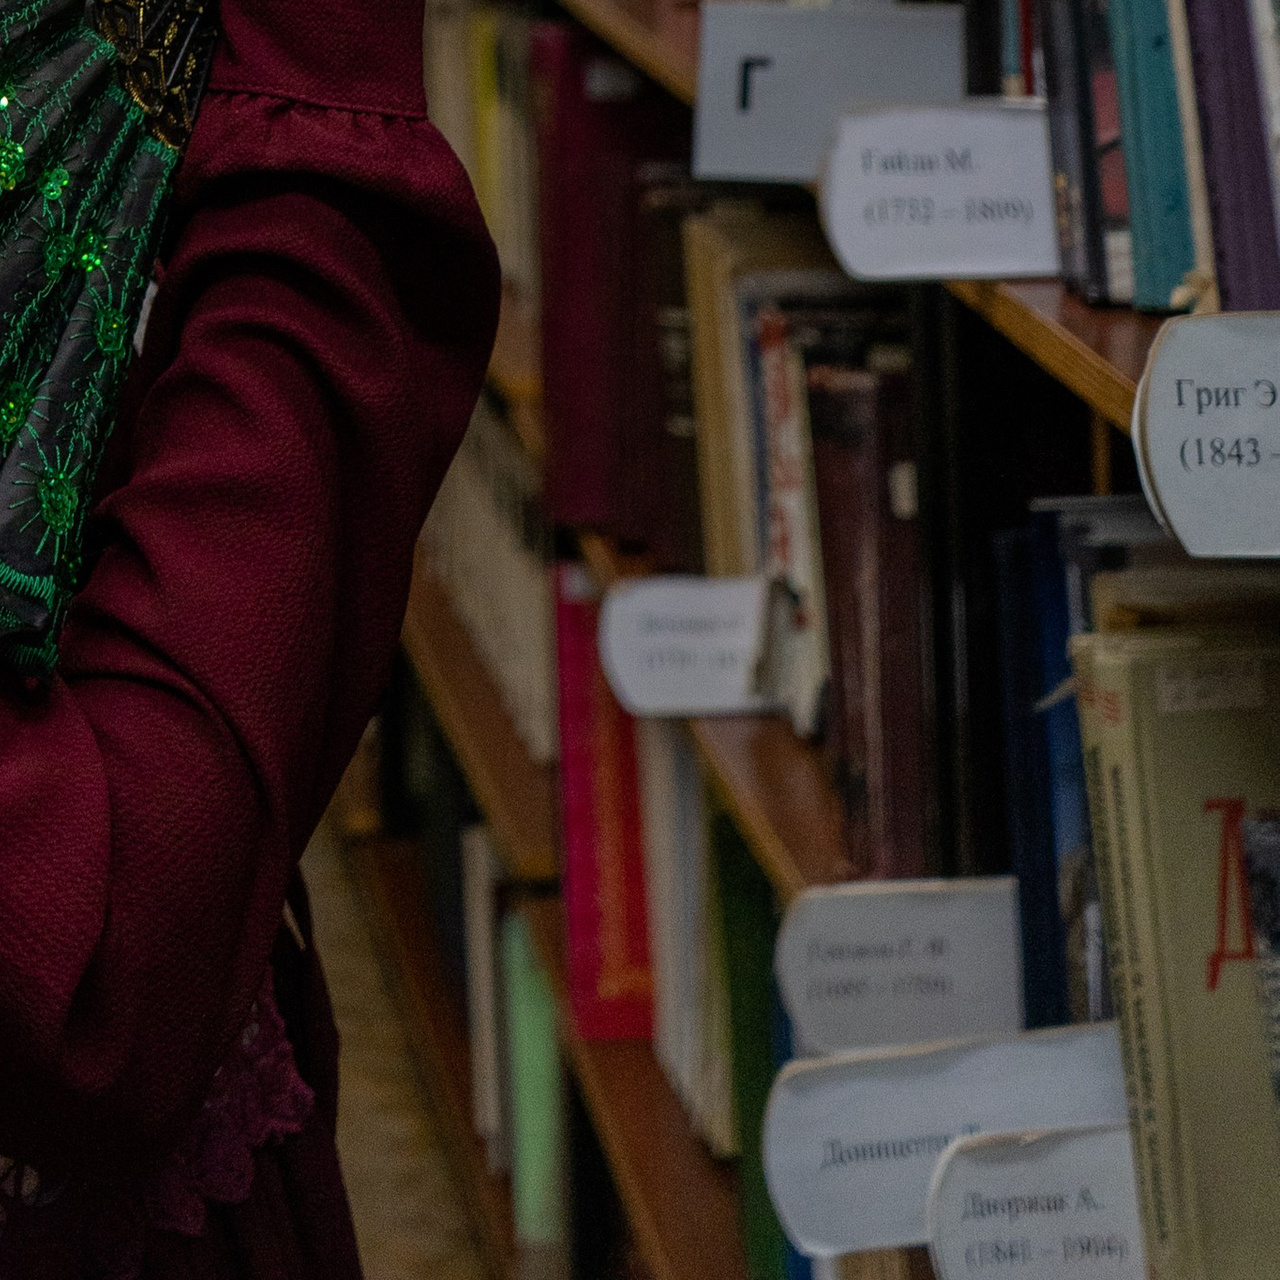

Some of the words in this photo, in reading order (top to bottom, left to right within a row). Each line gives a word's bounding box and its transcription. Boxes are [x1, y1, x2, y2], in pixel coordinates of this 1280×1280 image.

[738, 56, 773, 112] Г
[1175, 378, 1247, 415] Григ
[1179, 437, 1262, 473] (1843
